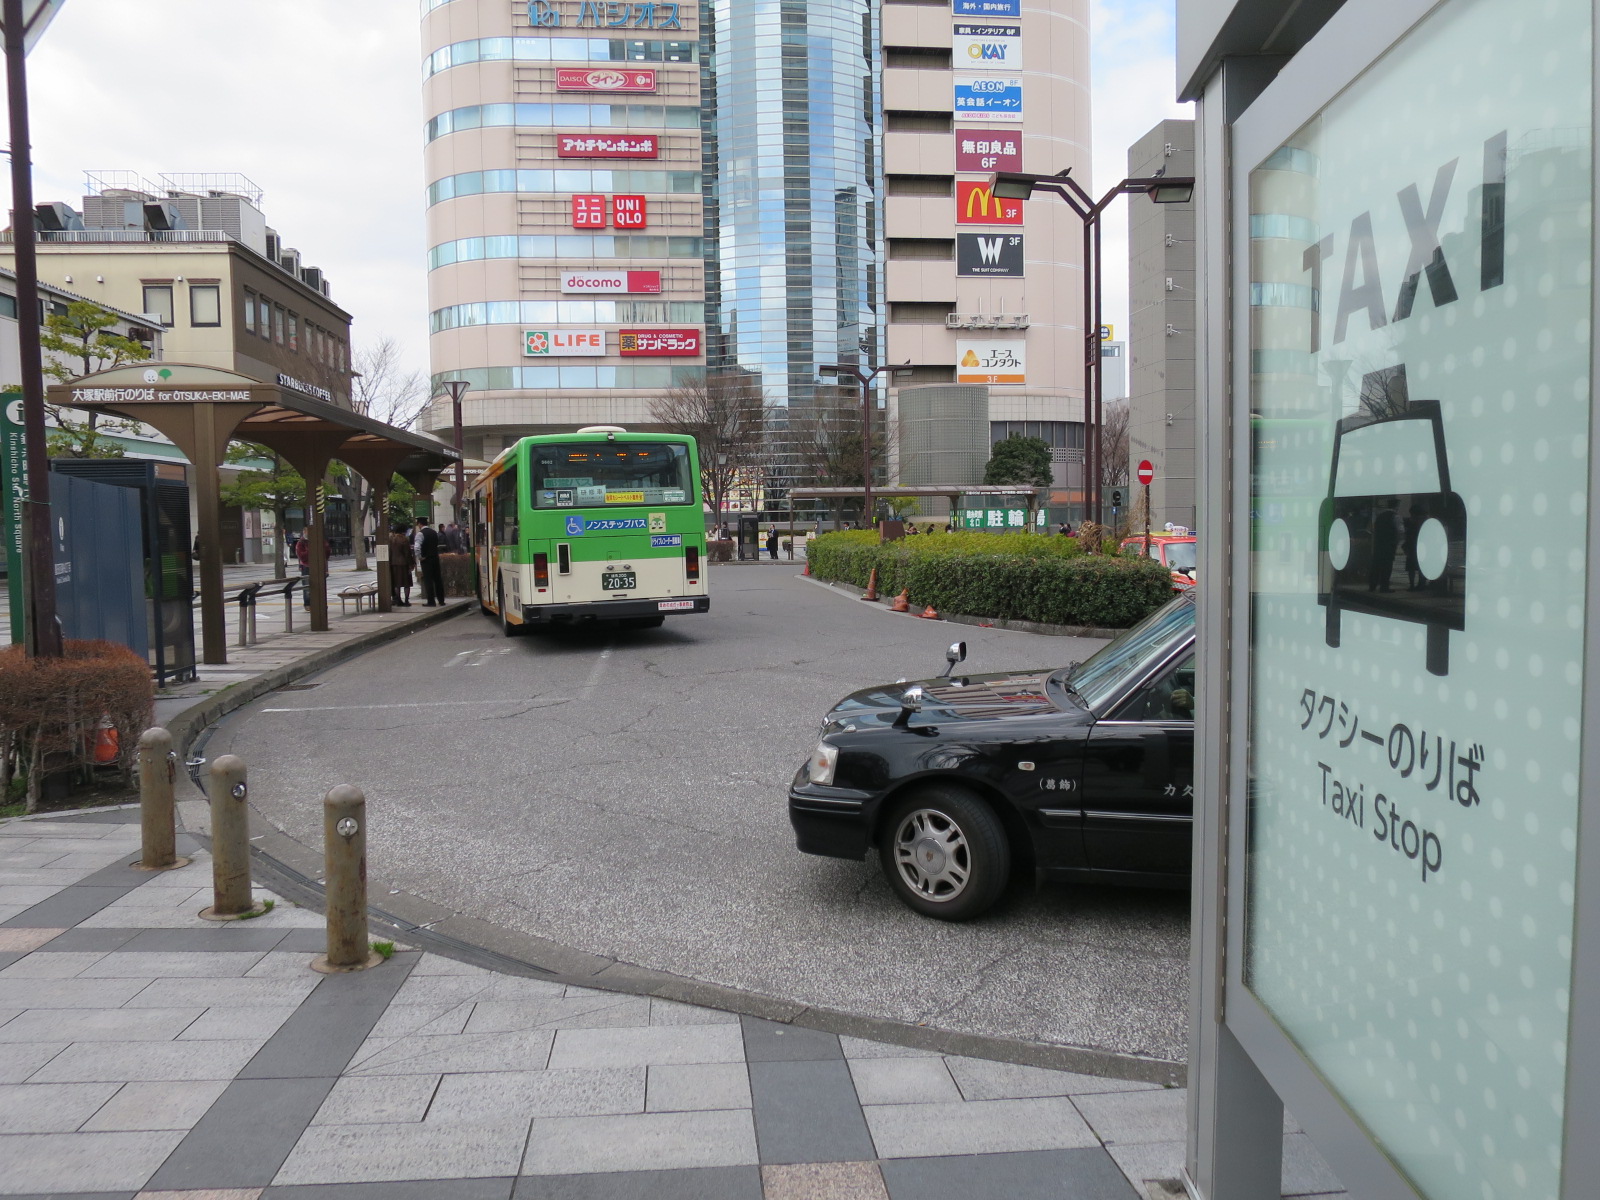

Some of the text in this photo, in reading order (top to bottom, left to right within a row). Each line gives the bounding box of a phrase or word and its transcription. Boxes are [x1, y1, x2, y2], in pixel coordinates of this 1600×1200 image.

[962, 2, 1011, 11] 海外・国内旅行
[576, 0, 682, 27] パシオス
[968, 43, 1008, 60] OKAY
[590, 74, 624, 85] ダイソー
[973, 80, 1005, 92] AEON
[956, 97, 1020, 107] 英会話イーオン
[961, 139, 1017, 155] 無印良品
[981, 157, 997, 168] 6F
[576, 198, 601, 210] ユニ
[616, 198, 640, 211] UNI
[576, 212, 601, 224] クロ
[616, 212, 642, 225] QLO
[1005, 209, 1017, 218] 3F
[1009, 237, 1021, 245] 3F
[1302, 129, 1508, 355] TAXI
[567, 276, 622, 288] docomo
[553, 334, 600, 347] LIFE
[637, 338, 696, 350] サンドラッグ
[990, 349, 1013, 359] エース
[981, 358, 1021, 368] コンタクト
[986, 375, 998, 383] 3F
[72, 388, 155, 401] 大塚駅前行のりば
[158, 392, 172, 401] for
[586, 518, 647, 530] ノンステップバス
[1300, 687, 1485, 808] タクシーのりば
[1317, 760, 1442, 883] Taxi Stop
